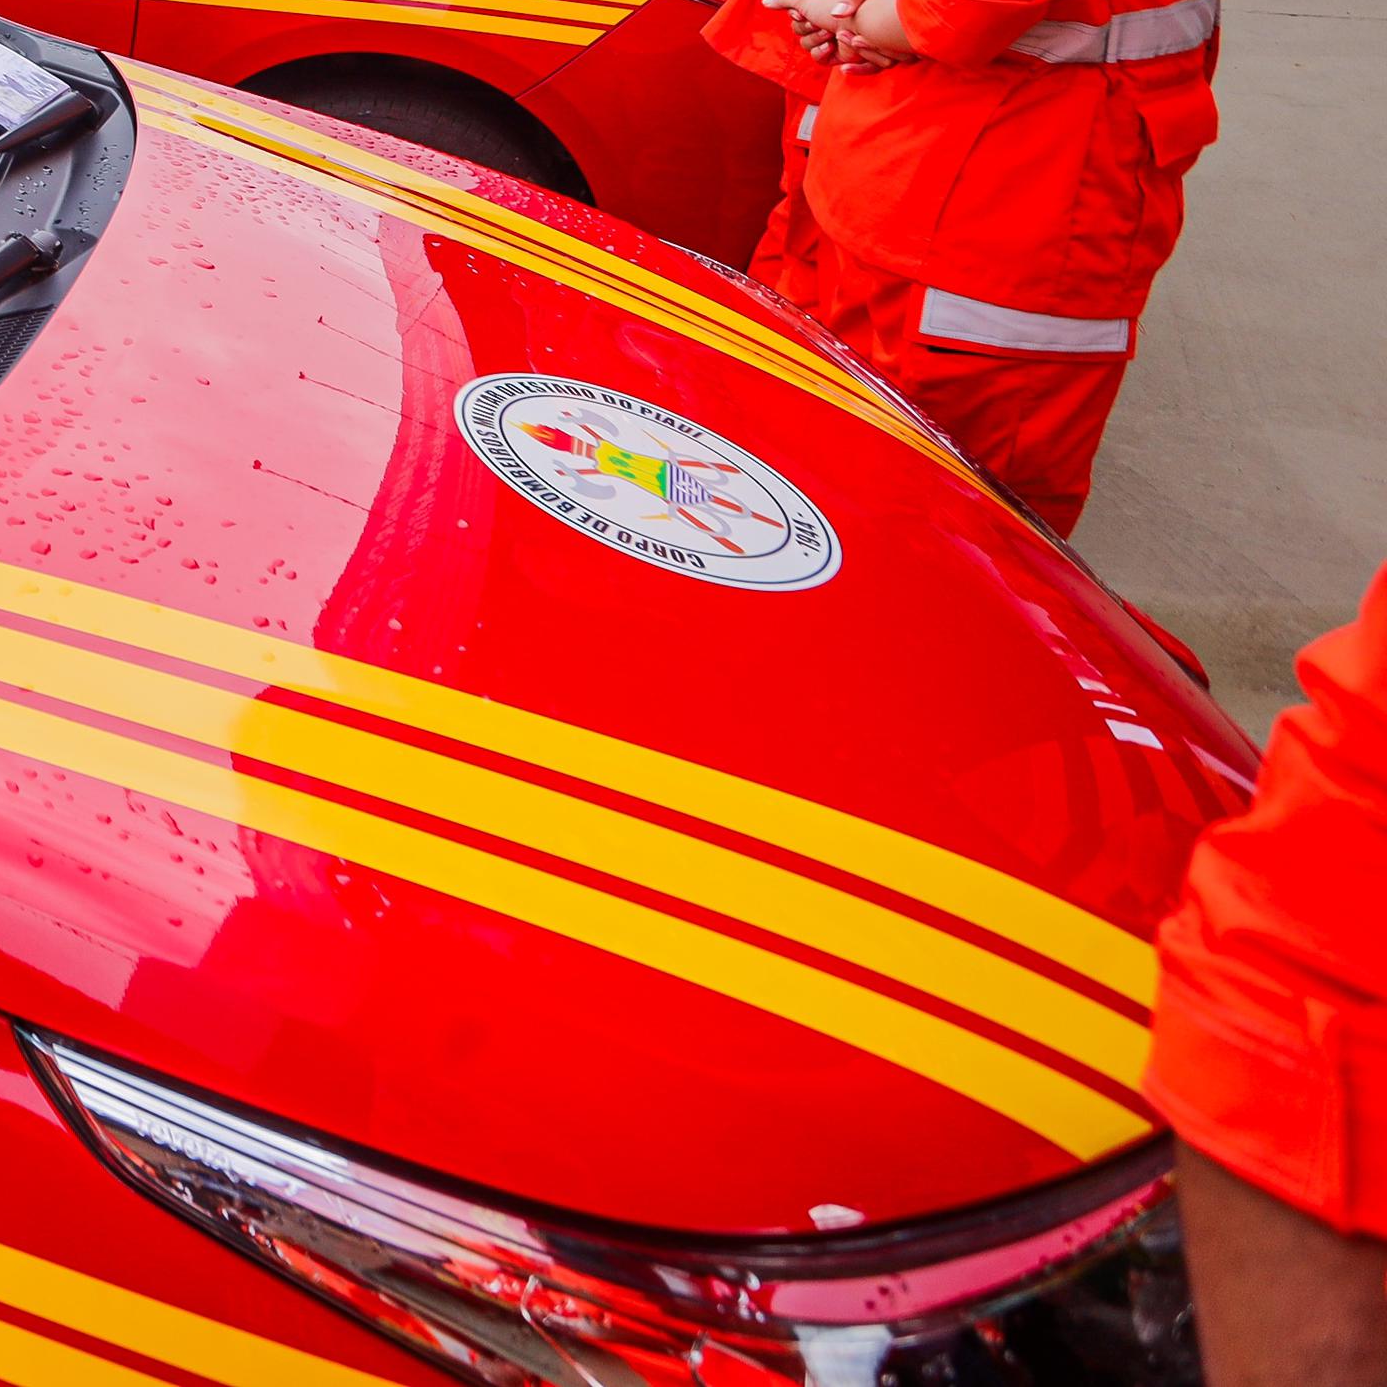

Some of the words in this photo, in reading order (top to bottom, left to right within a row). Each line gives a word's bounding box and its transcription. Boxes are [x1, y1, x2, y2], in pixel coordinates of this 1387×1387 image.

[501, 382, 522, 399] DO
[524, 379, 597, 401] ESTADO
[601, 393, 634, 410] DO
[472, 387, 508, 429] MILITAR
[480, 426, 574, 514] BOMBEIROS
[576, 509, 614, 536] DE
[617, 527, 705, 569] CORPO
